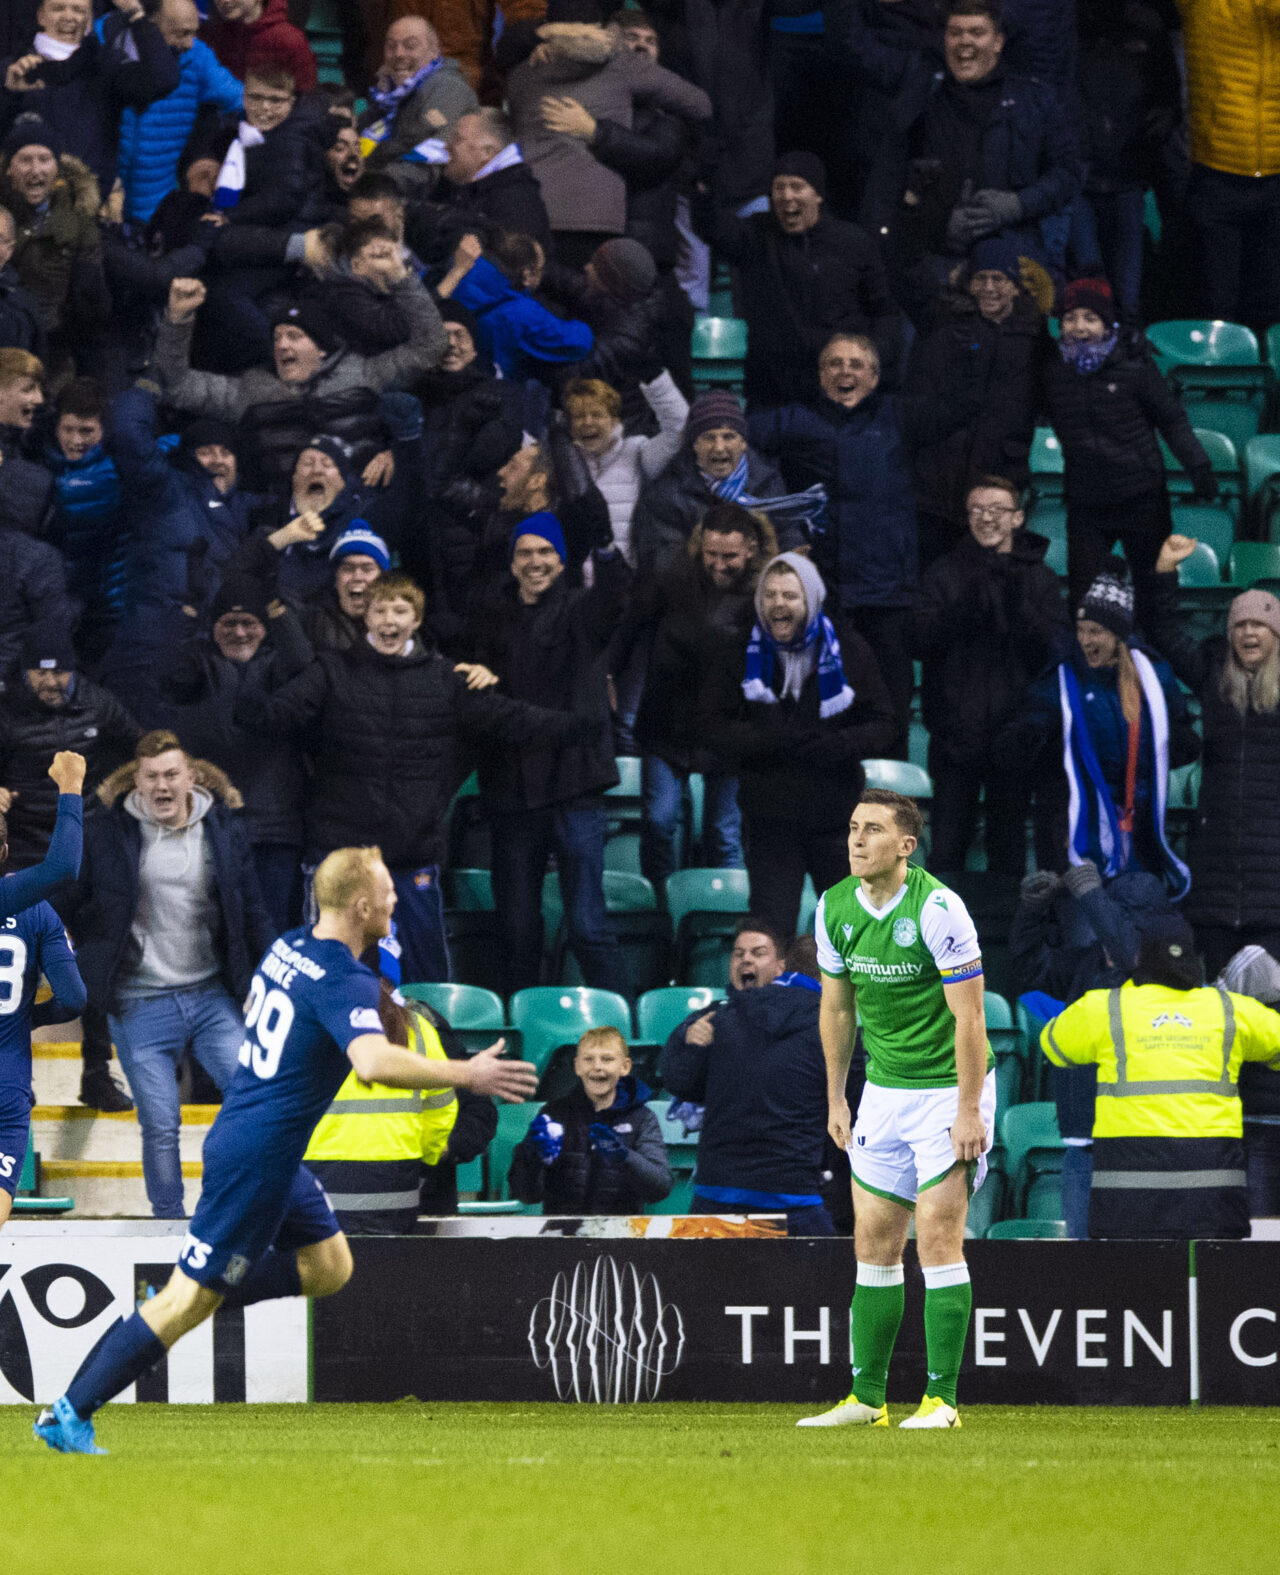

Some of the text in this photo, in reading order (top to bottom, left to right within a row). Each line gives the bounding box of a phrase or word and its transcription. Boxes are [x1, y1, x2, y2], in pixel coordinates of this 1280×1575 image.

[870, 974, 915, 984] Foundation
[725, 1306, 1173, 1367] TH EVEN
[1229, 1307, 1277, 1367] C
